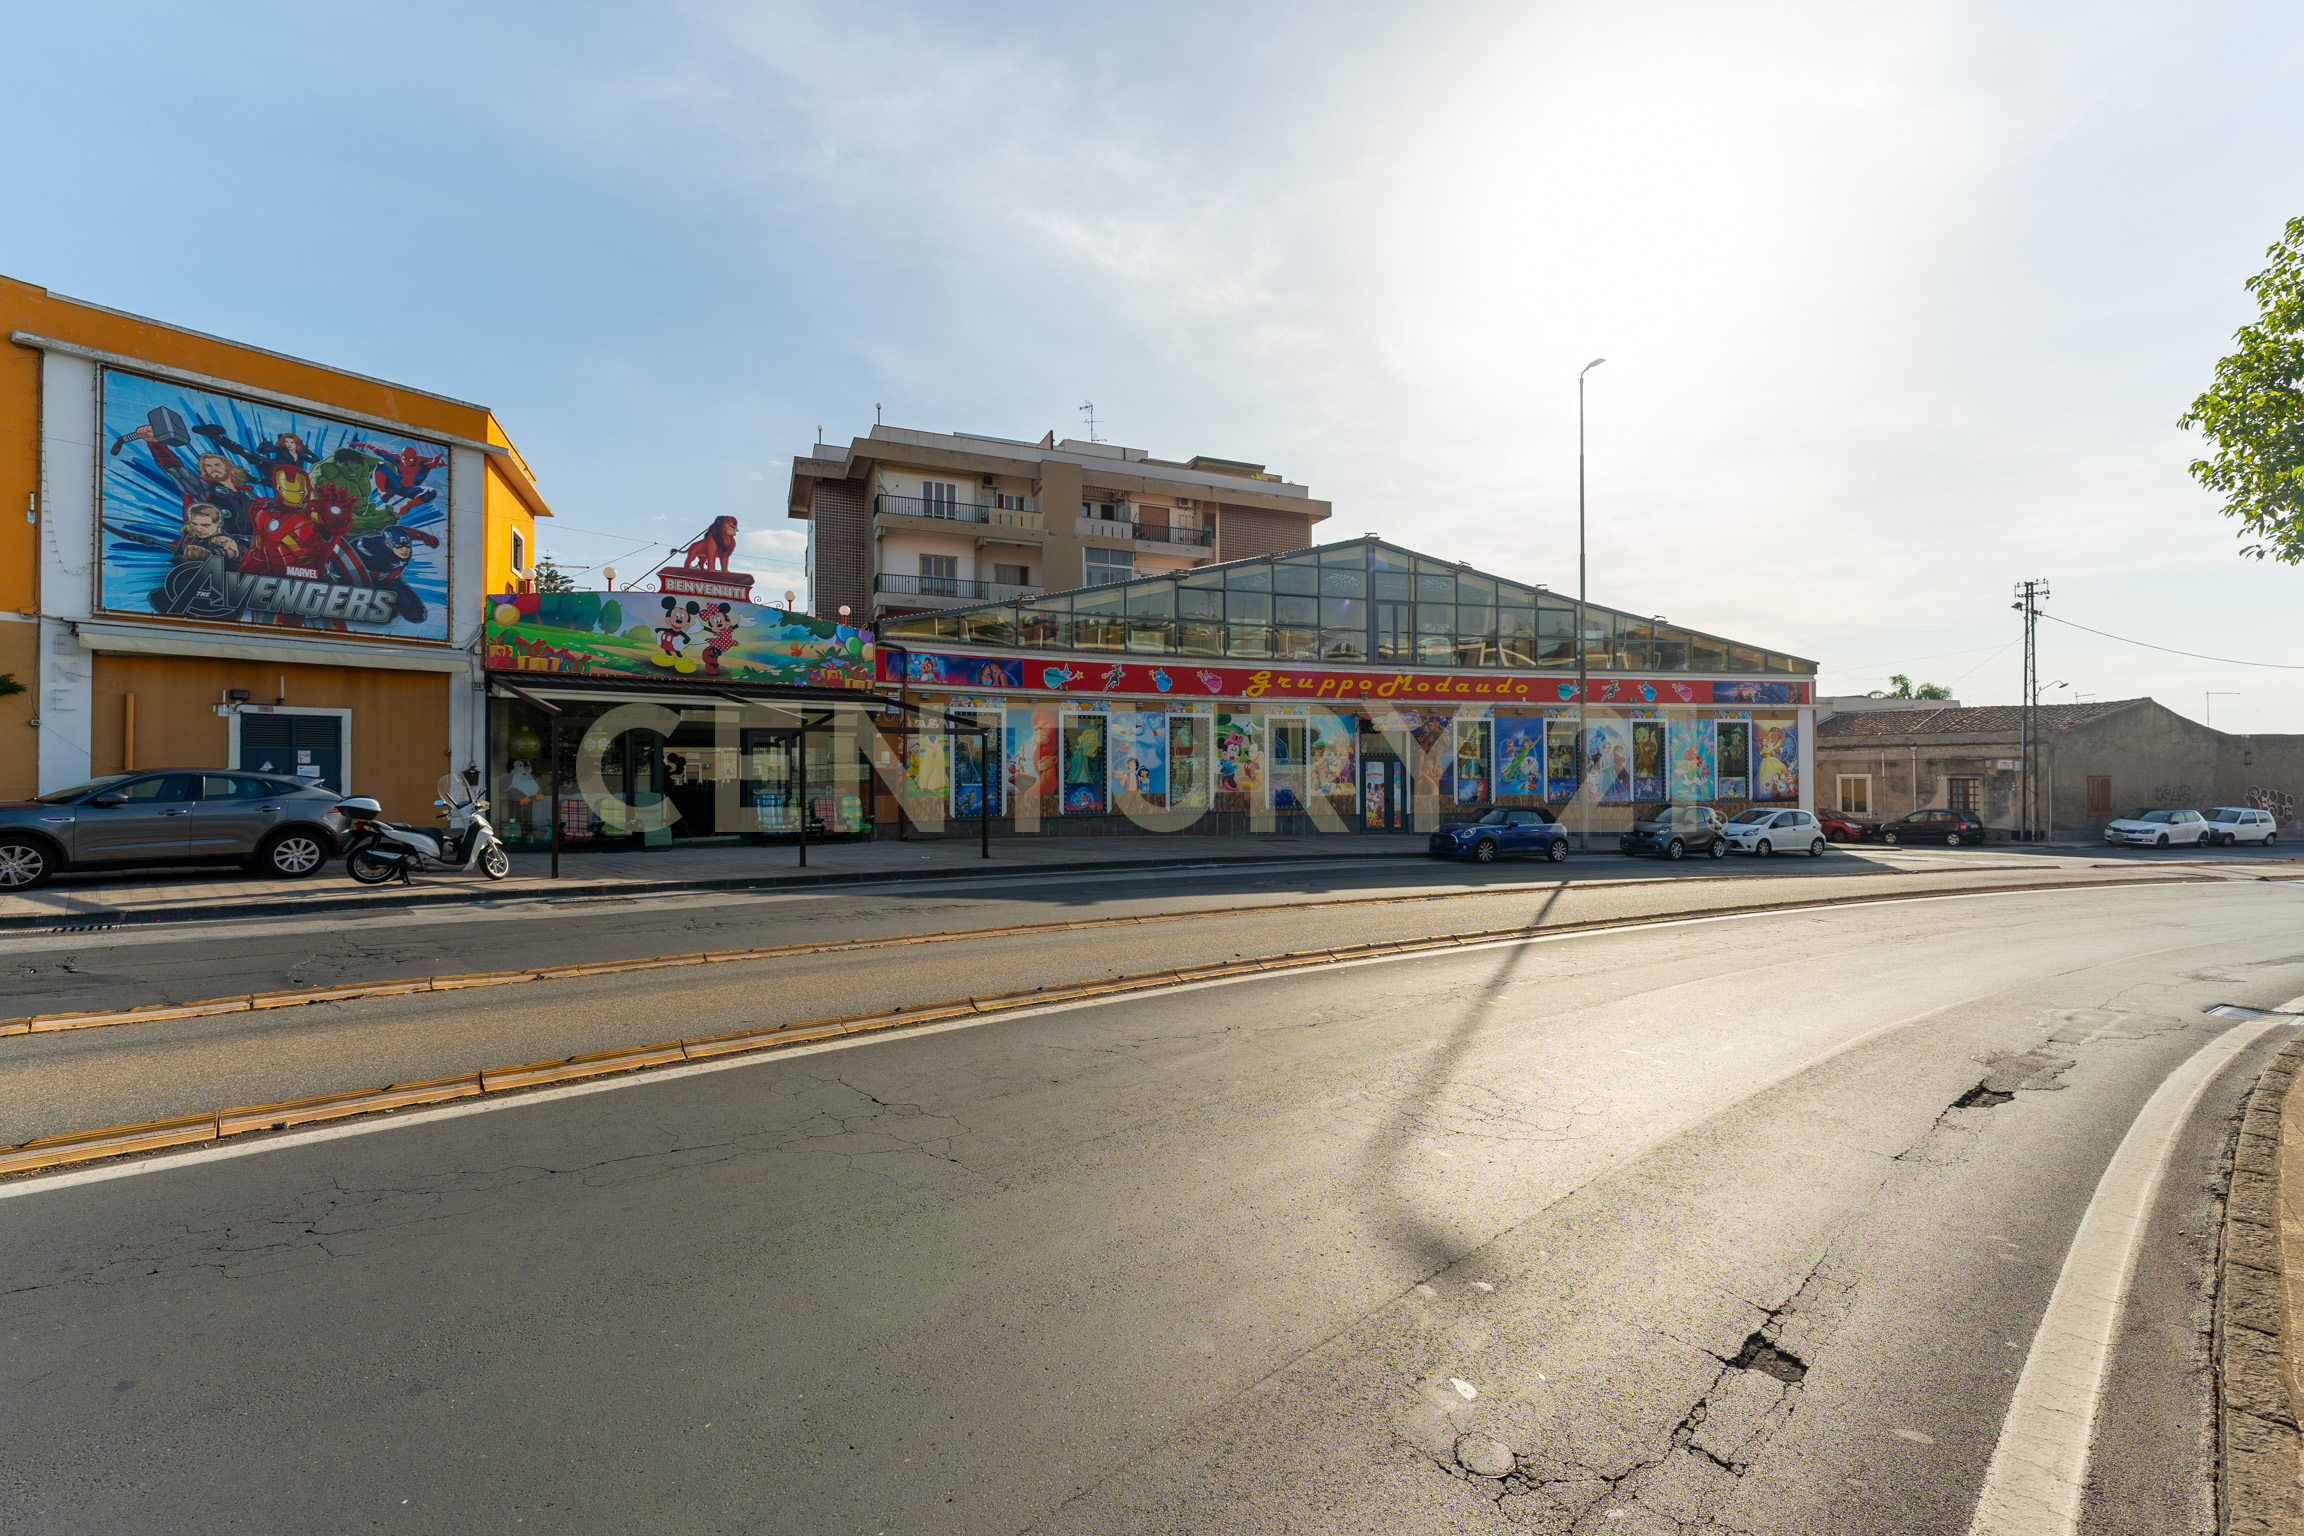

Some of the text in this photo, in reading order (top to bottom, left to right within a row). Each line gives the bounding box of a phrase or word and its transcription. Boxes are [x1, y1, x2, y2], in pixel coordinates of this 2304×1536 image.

[286, 566, 319, 579] MARVEL
[164, 555, 398, 624] AVENGERS
[196, 590, 211, 598] THE
[665, 577, 747, 600] BENVENUTI
[1246, 670, 1528, 698] Gruppo Modaudo
